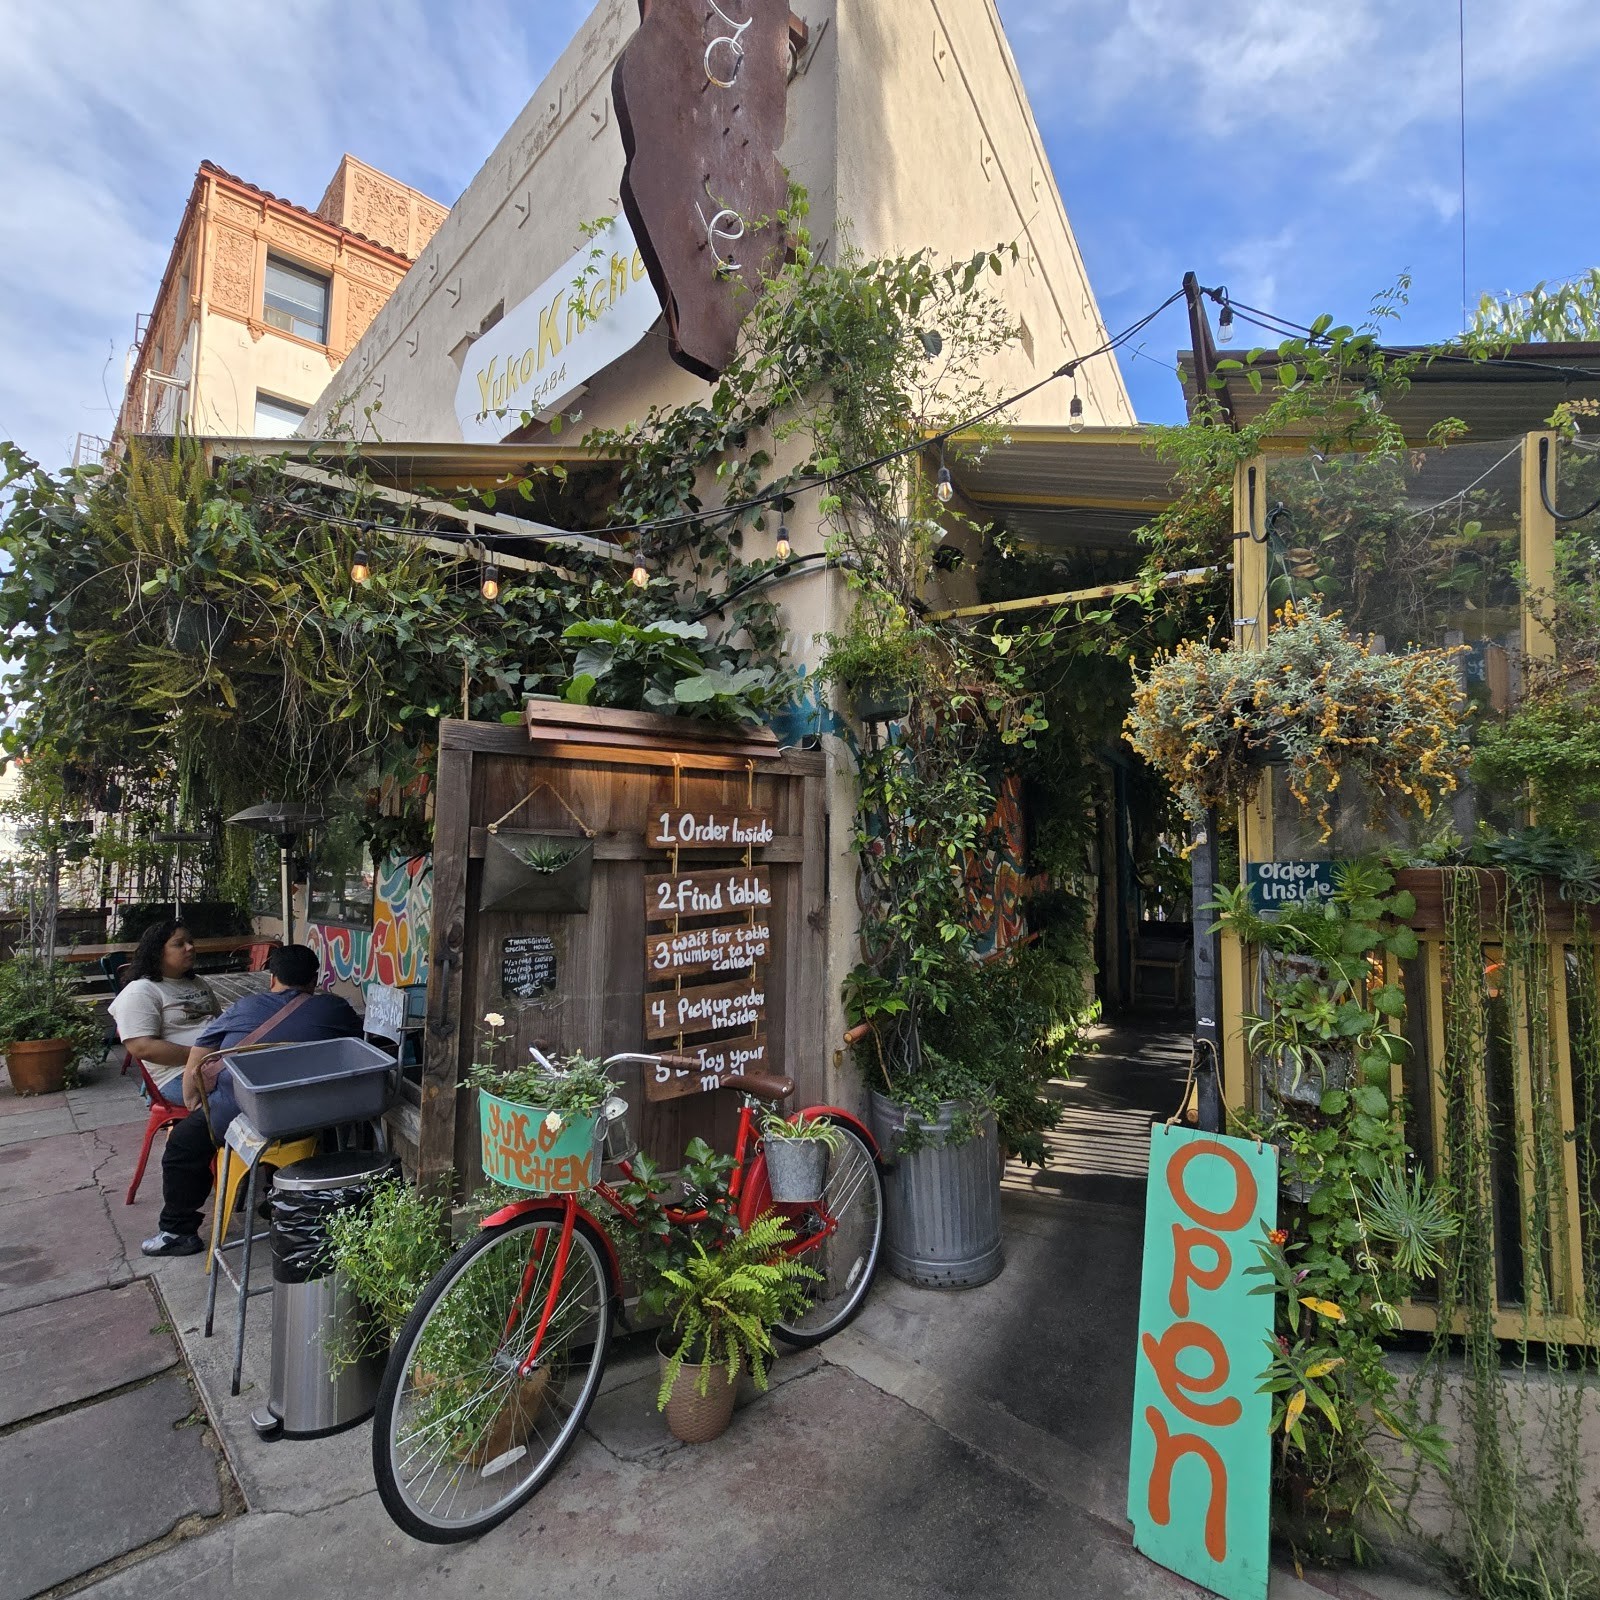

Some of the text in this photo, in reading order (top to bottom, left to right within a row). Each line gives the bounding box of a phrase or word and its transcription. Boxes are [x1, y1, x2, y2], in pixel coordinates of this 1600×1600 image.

[533, 363, 567, 401] 5484
[656, 812, 773, 843] 1 Order Inside
[1258, 861, 1320, 882] order
[657, 876, 772, 912] 2 Find table
[672, 924, 770, 951] wait for table
[653, 942, 765, 969] 3 number to be
[712, 956, 754, 971] called
[652, 999, 666, 1028] 4
[734, 987, 765, 1008] order
[711, 1008, 759, 1030] Inside
[729, 1045, 765, 1069] your
[1141, 1138, 1259, 1563] Open
